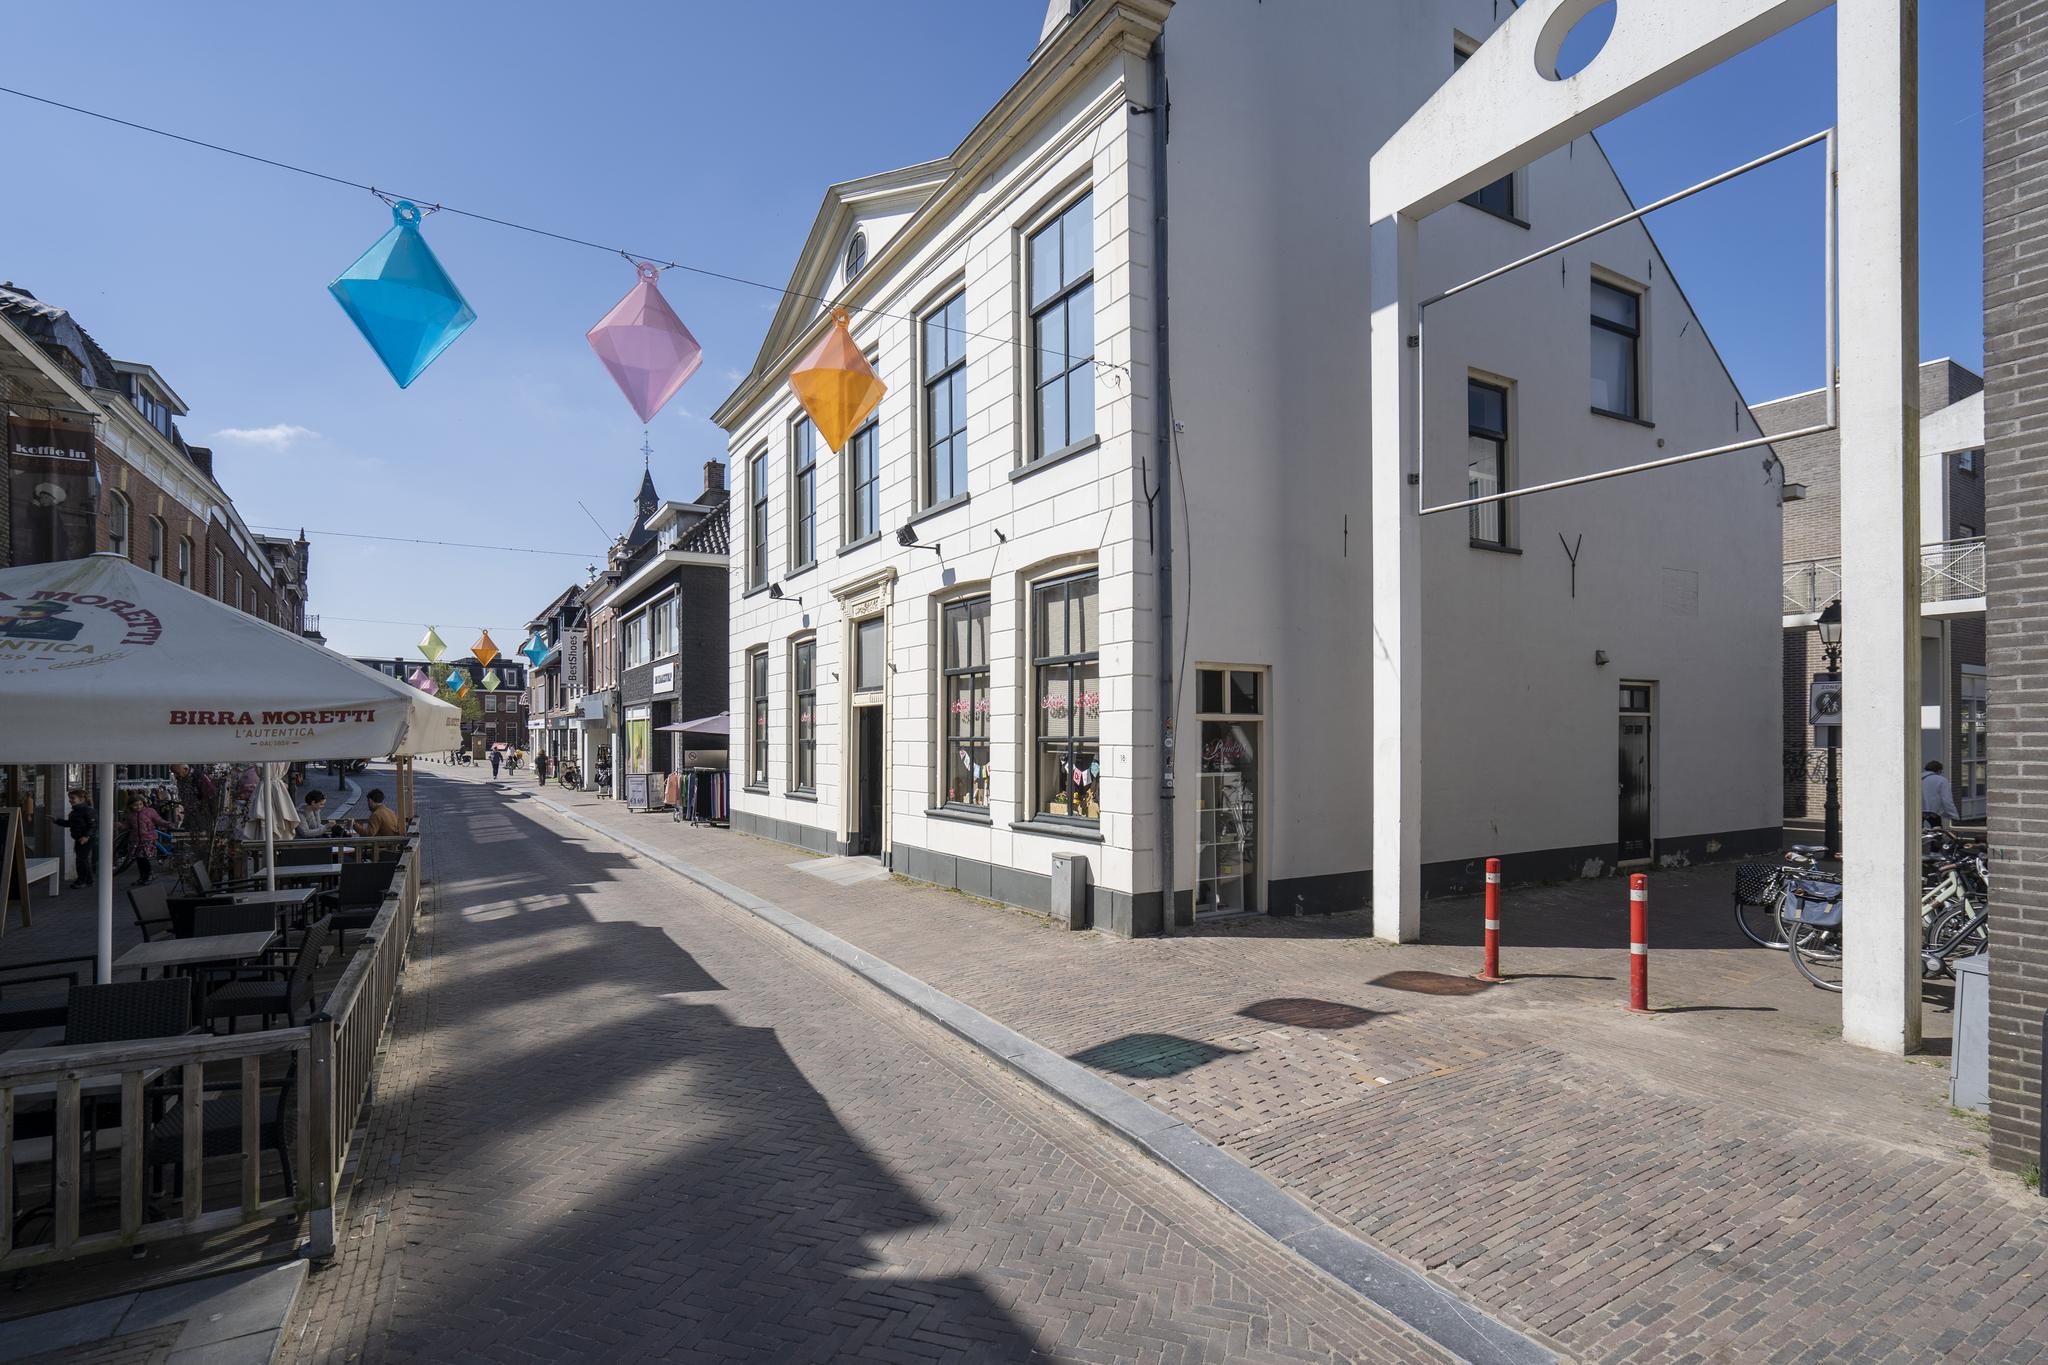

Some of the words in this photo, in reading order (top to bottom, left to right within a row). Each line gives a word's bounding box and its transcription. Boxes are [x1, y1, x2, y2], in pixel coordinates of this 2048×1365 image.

[15, 443, 65, 457] koffie
[69, 448, 86, 459] in
[26, 591, 163, 646] MORETTI
[568, 635, 577, 681] BestShoes
[169, 710, 255, 725] BIRRA
[262, 709, 376, 725] MORETTI
[235, 727, 315, 738] L'AUTENTICA
